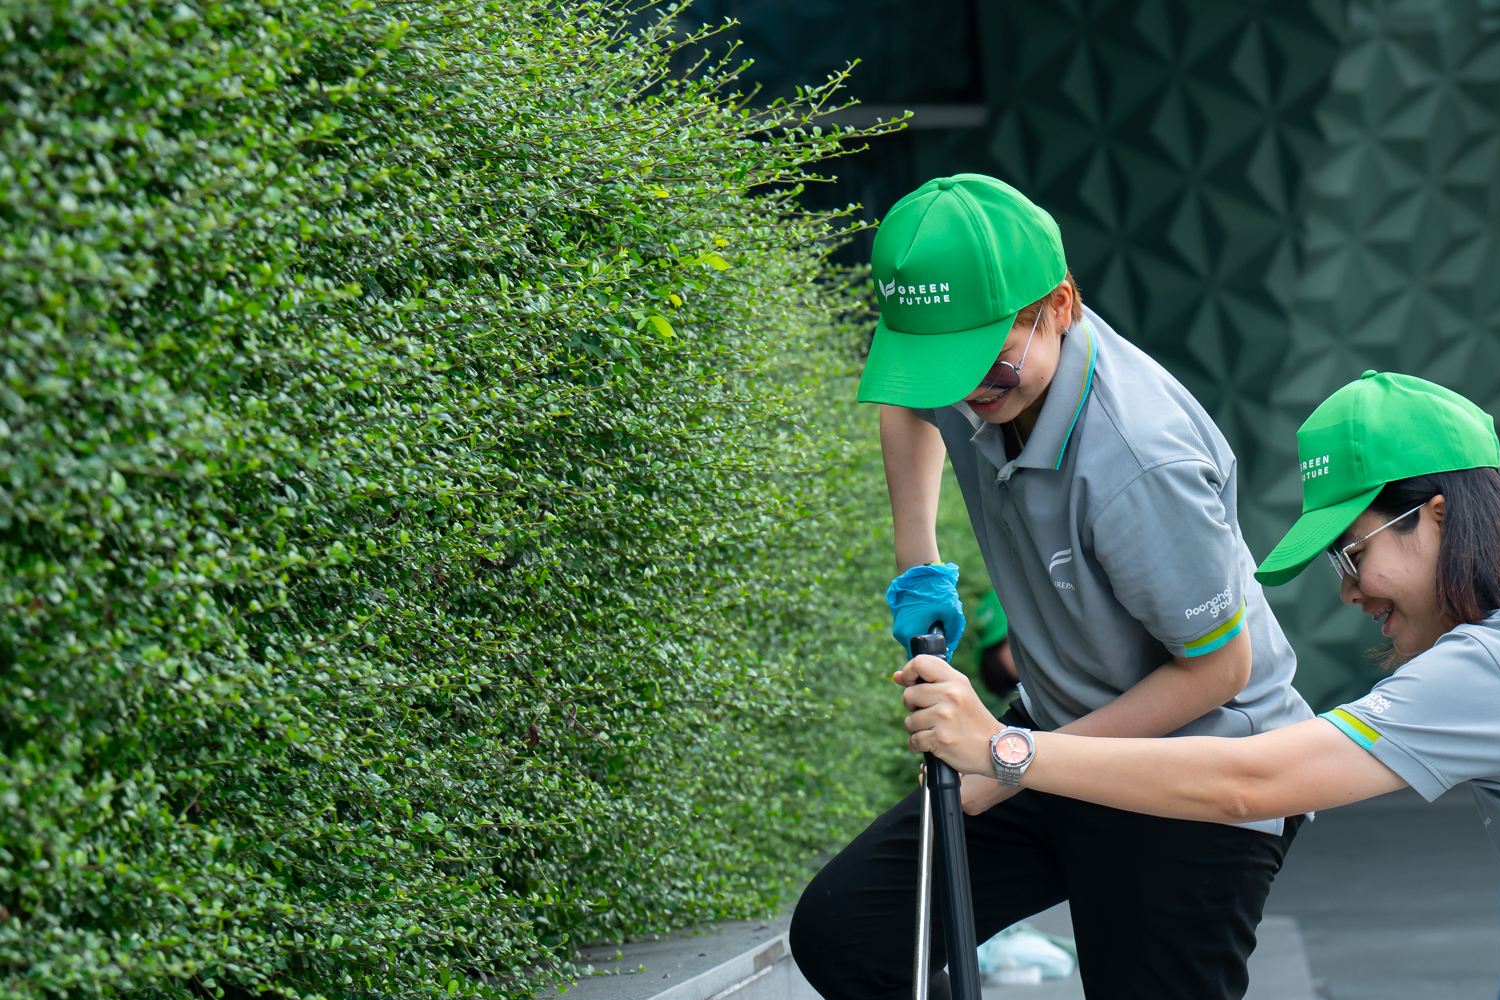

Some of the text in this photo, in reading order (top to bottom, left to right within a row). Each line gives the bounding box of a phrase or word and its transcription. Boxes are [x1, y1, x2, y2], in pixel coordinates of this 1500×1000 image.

[897, 282, 950, 295] GREEN
[899, 294, 951, 305] FUTURE
[1301, 466, 1330, 482] UTURE
